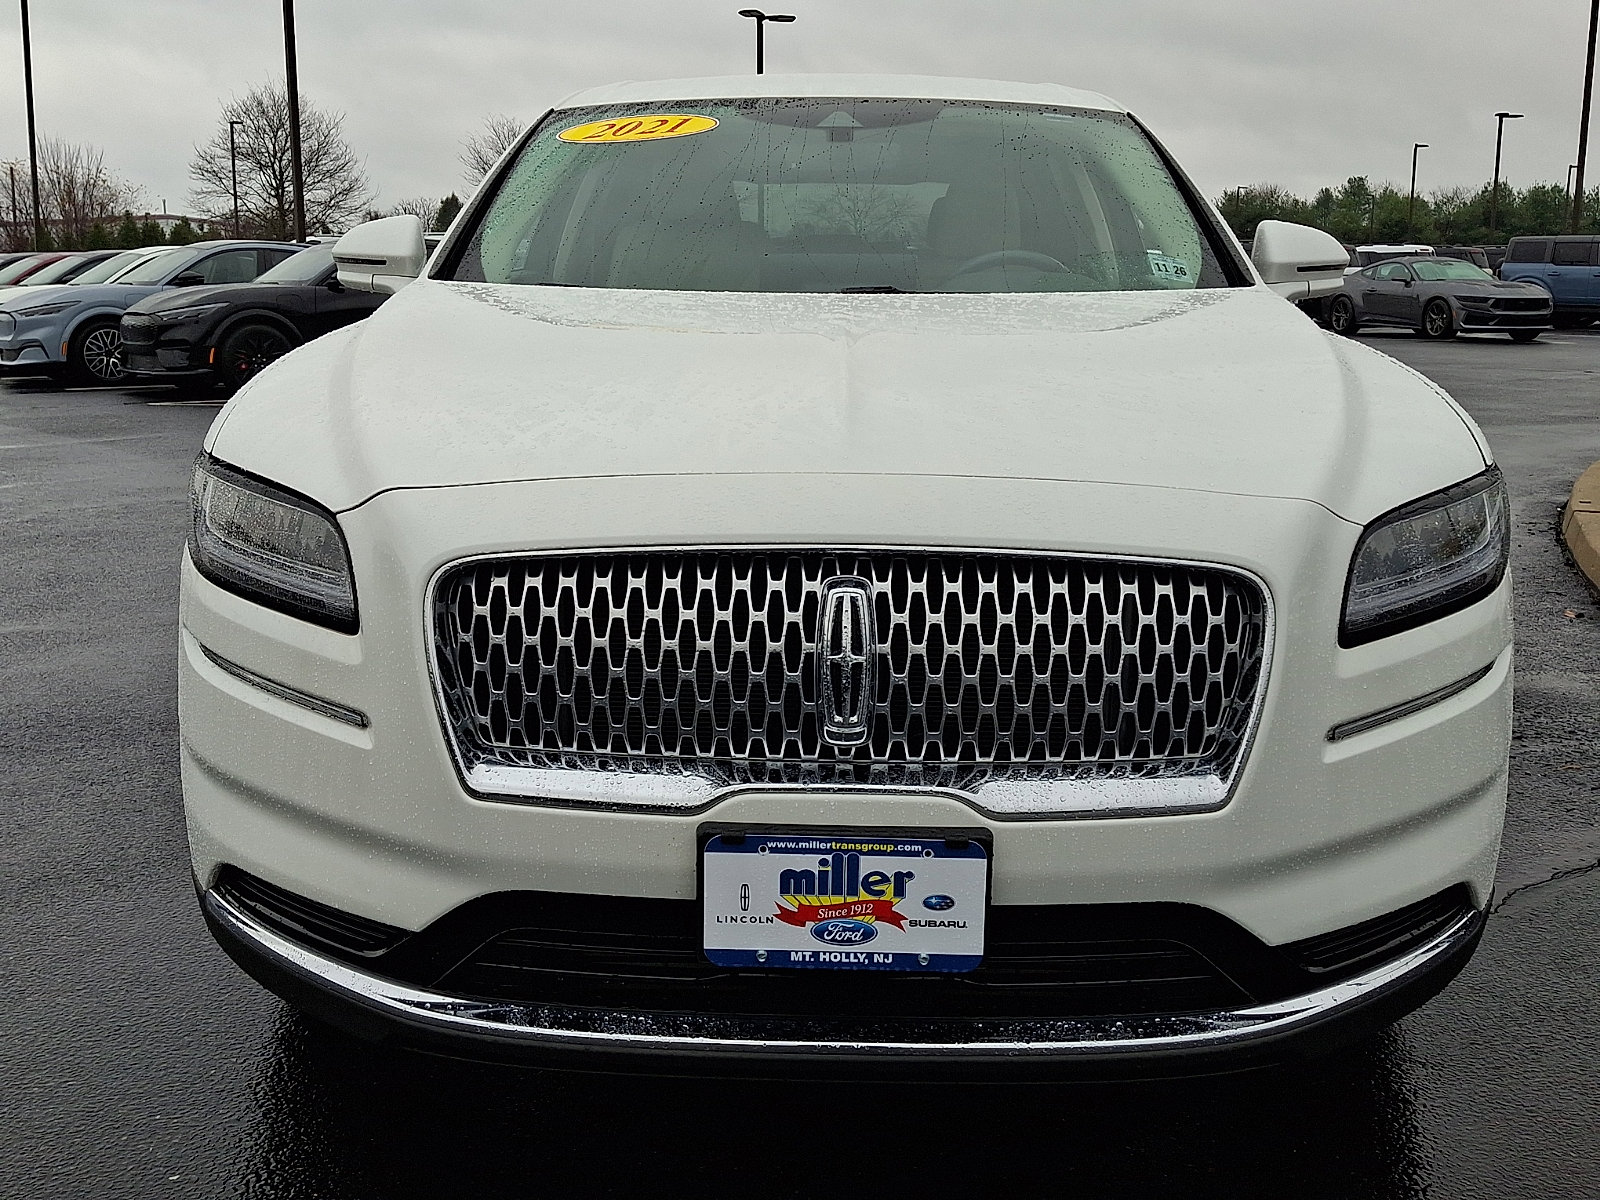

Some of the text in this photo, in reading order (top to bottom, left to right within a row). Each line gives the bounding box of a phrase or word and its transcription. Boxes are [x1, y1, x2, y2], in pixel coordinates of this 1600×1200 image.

[582, 118, 692, 139] 2021
[767, 840, 922, 852] www.millertransgroup.com
[779, 853, 915, 898] miller
[818, 903, 873, 919] Since 1912
[716, 915, 774, 924] LINCOLN
[824, 923, 865, 941] Ford
[791, 952, 892, 964] MT. HOLLY, NJ
